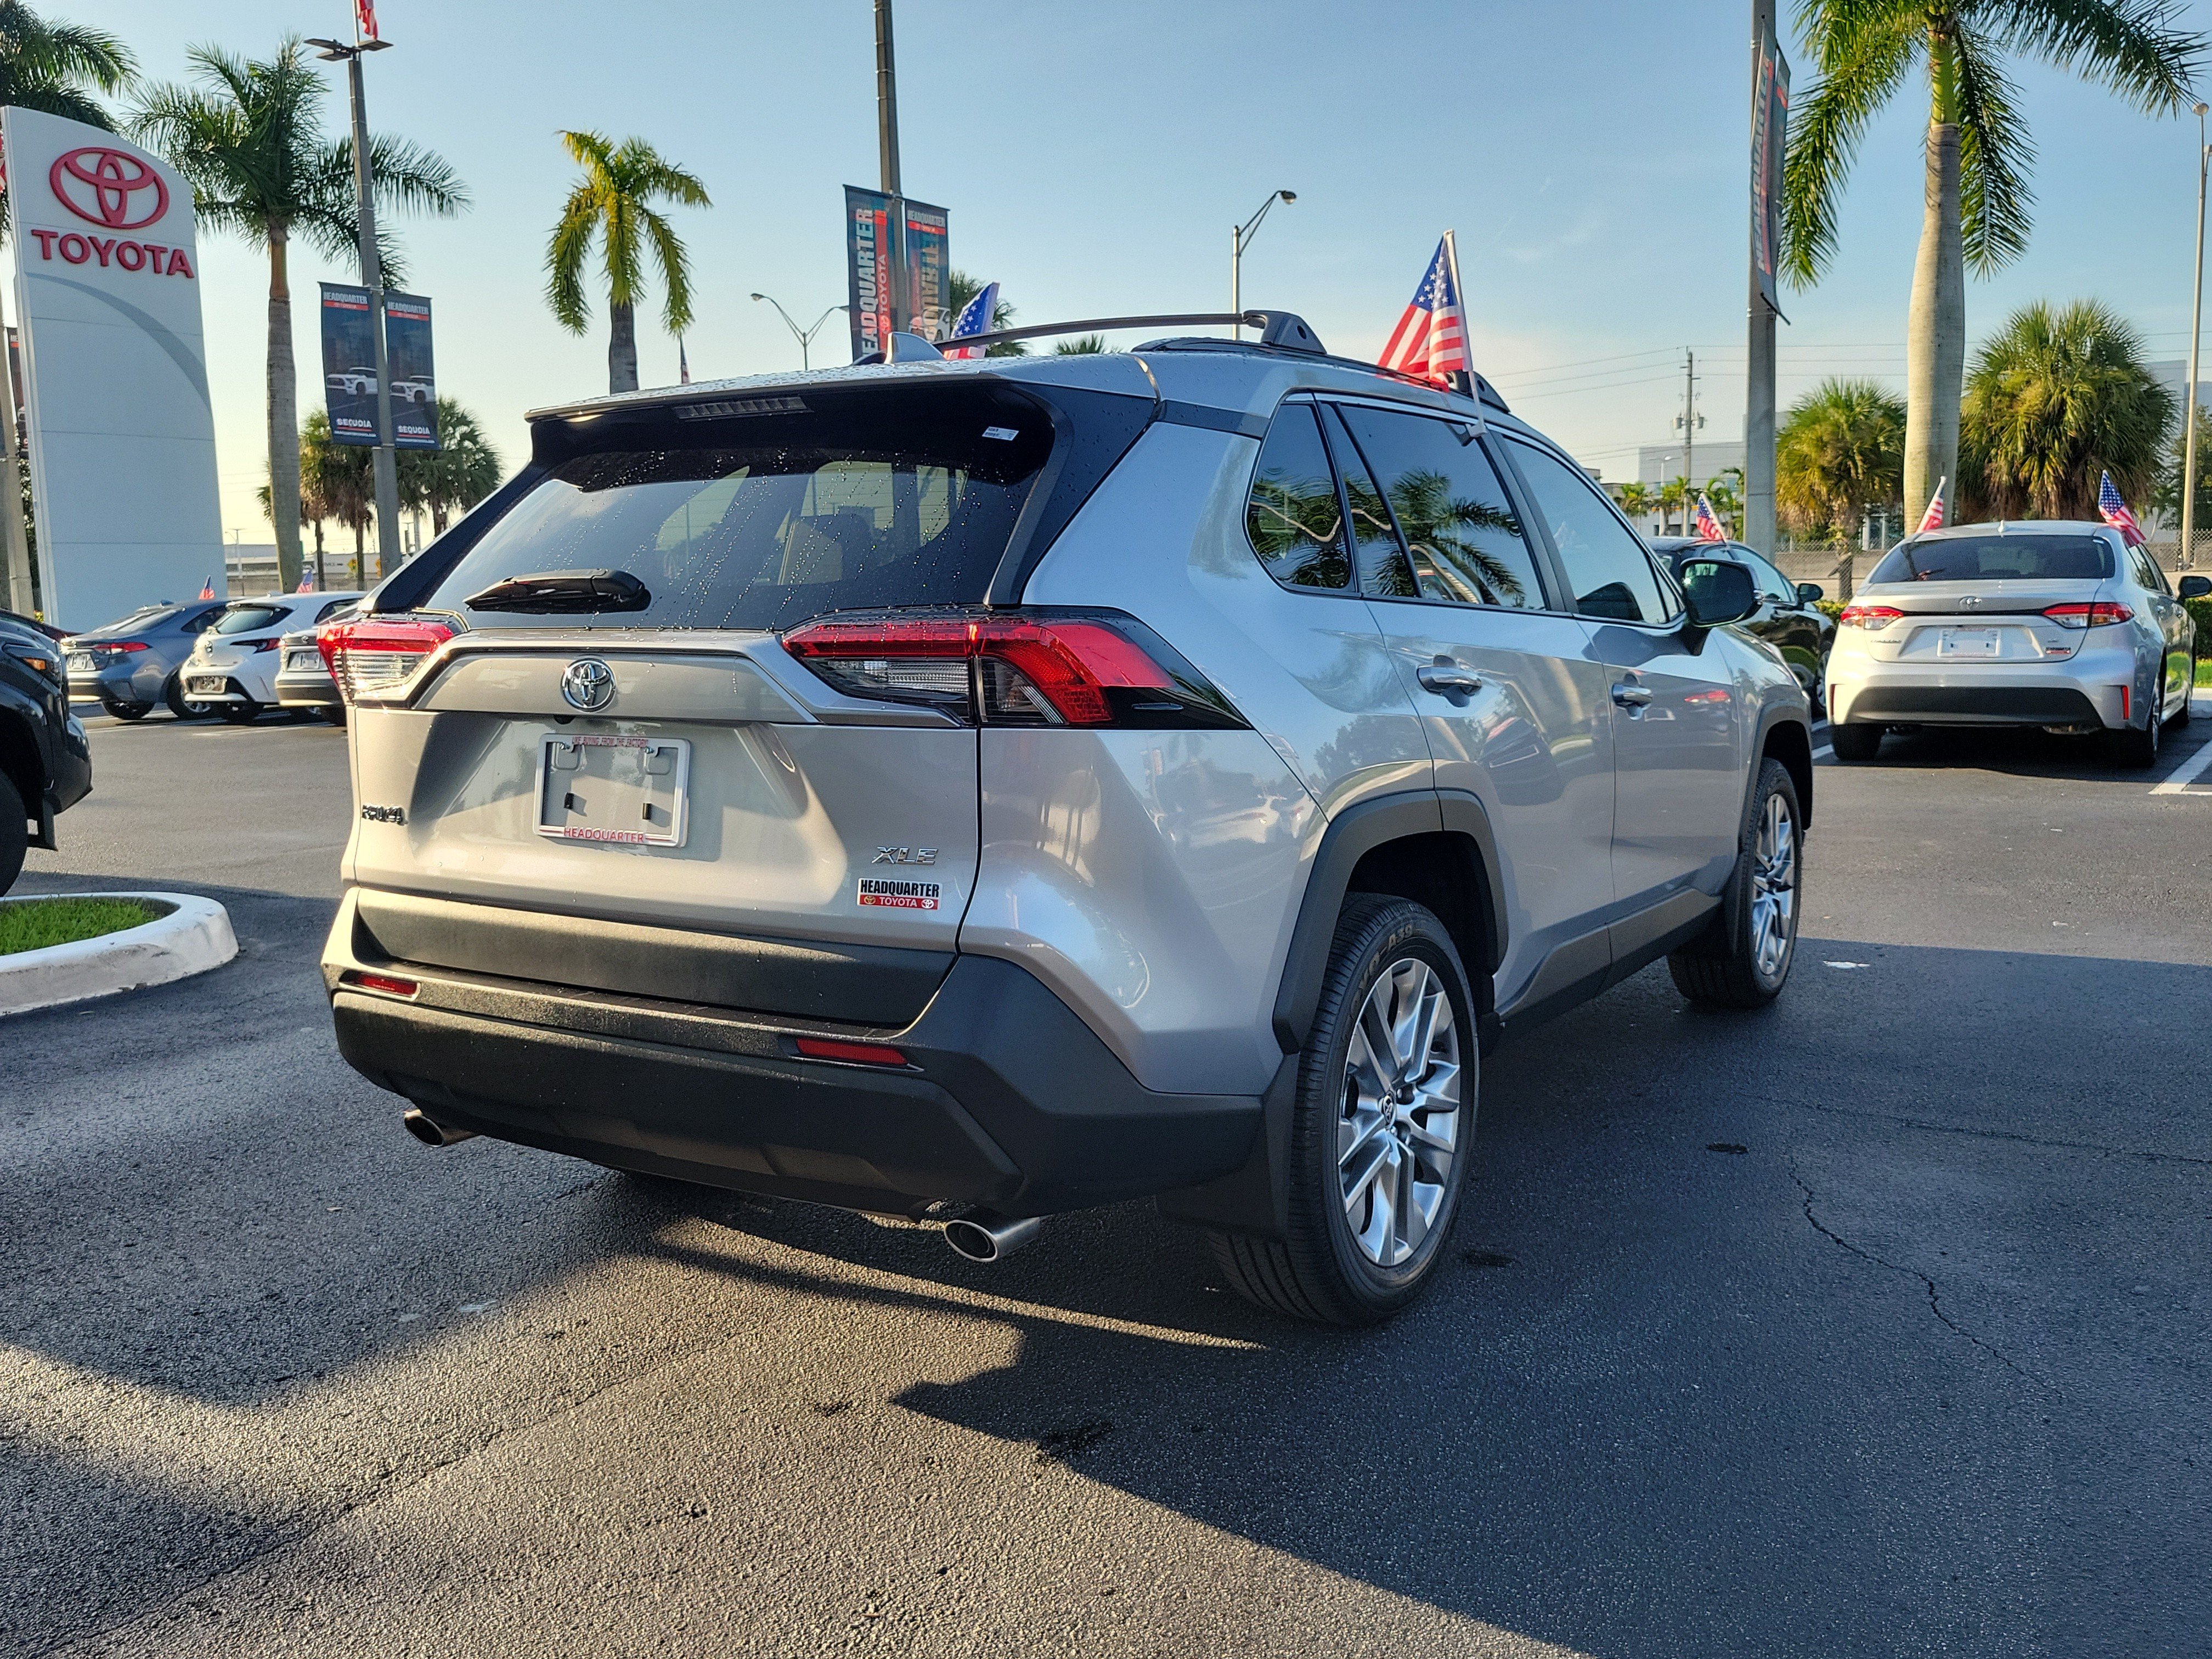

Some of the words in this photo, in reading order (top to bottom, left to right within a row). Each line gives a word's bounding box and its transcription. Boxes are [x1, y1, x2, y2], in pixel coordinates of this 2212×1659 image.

[31, 229, 195, 278] TOYOTA
[856, 209, 878, 357] EADQUARTER
[878, 254, 889, 313] TOYOTA
[324, 291, 368, 304] HEADQUARTER
[387, 301, 429, 315] HEADQUARTER
[336, 418, 373, 428] SEQUOIA
[397, 425, 431, 435] SEQUOIA
[563, 826, 644, 843] HEADQUARTER
[871, 847, 938, 865] XLE
[860, 879, 940, 898] HEADQUARTER
[879, 896, 917, 907] TOYOTA
